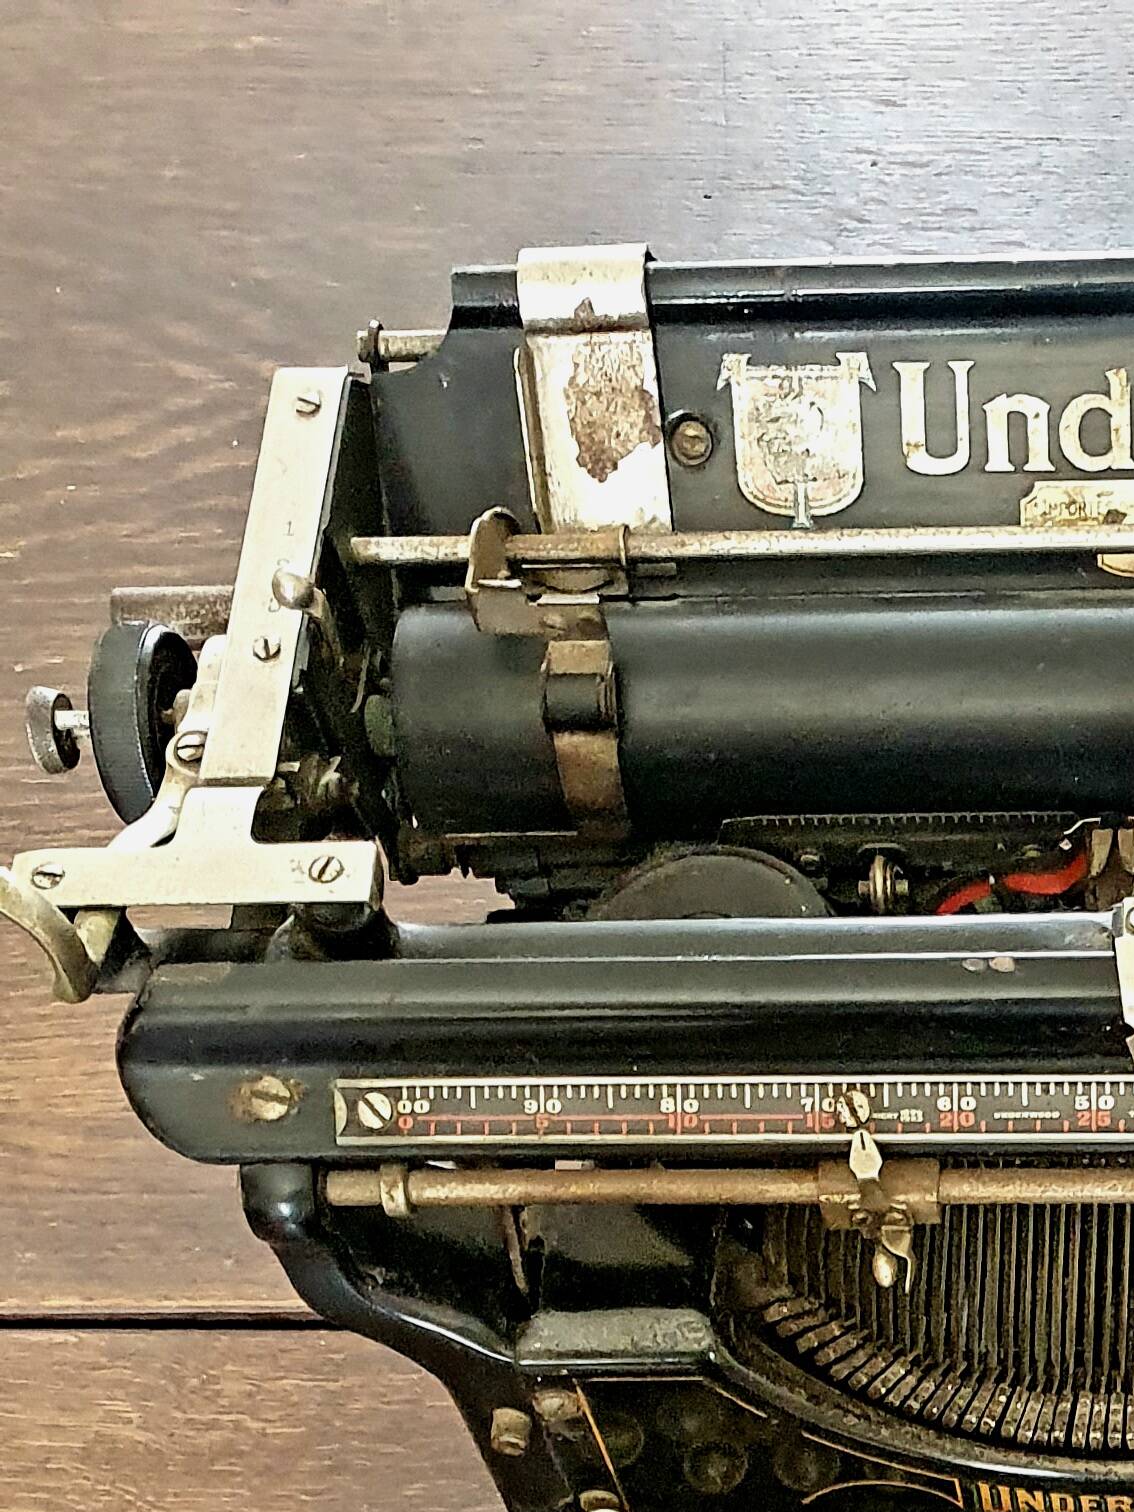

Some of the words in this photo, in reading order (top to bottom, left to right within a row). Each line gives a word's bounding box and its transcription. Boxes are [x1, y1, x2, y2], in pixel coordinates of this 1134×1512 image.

[522, 1099, 563, 1115] 90
[660, 1098, 699, 1114] 80
[800, 1096, 836, 1113] 70
[938, 1095, 977, 1112] 60
[1074, 1094, 1115, 1111] 50
[397, 1114, 414, 1130] 0
[667, 1114, 699, 1129] 10
[805, 1112, 837, 1129] 15
[939, 1111, 975, 1128] 20
[1077, 1111, 1111, 1128] 25
